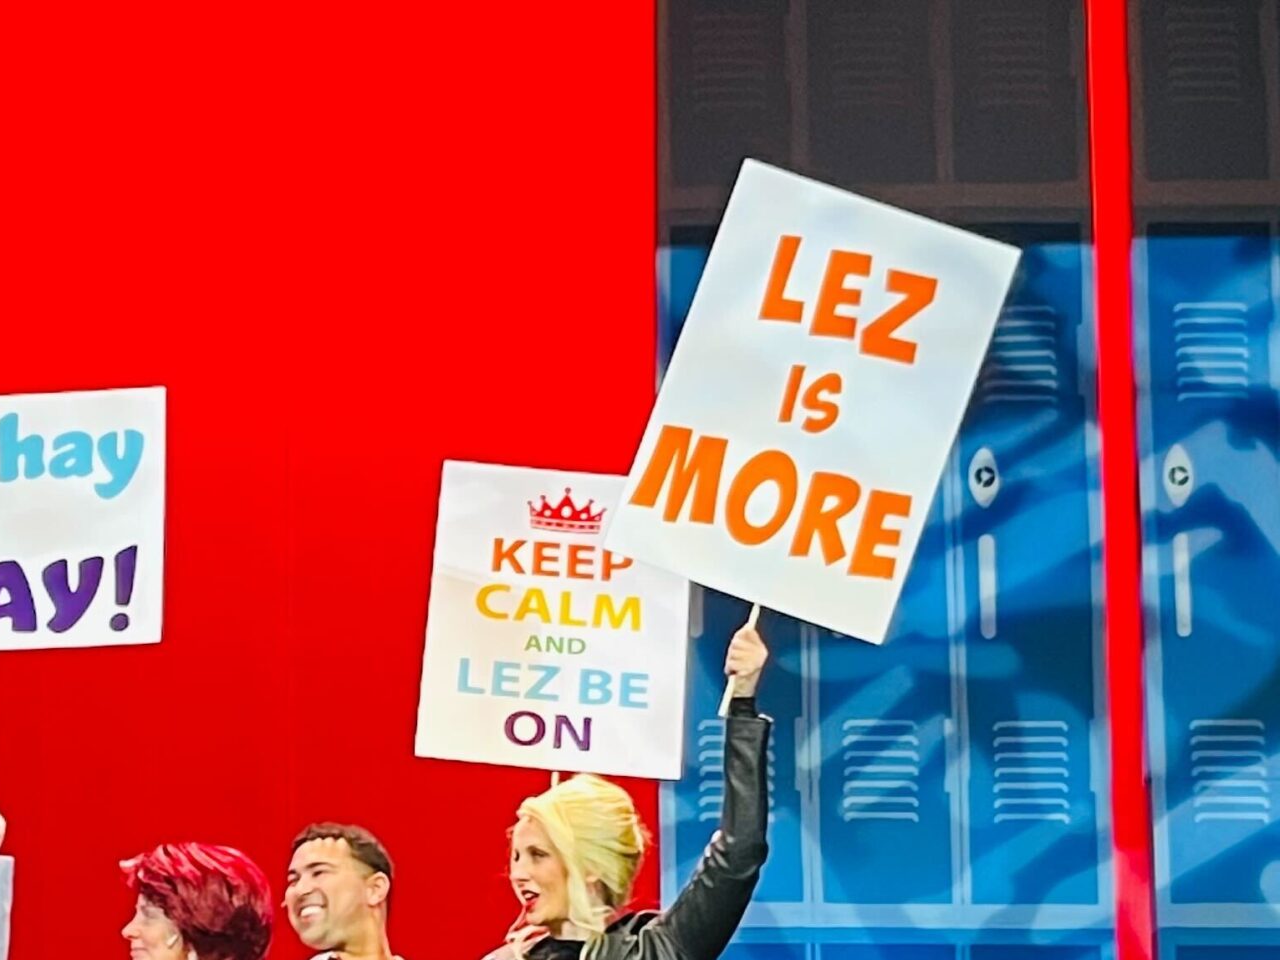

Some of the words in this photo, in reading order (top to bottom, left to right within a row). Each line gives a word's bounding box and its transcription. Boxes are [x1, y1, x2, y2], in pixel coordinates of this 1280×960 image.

[759, 235, 939, 365] LEZ
[778, 364, 842, 433] IS
[628, 425, 912, 580] MORE
[491, 537, 633, 582] KEEP
[475, 583, 642, 631] CALM
[524, 634, 586, 655] AND
[457, 657, 561, 702] LEZ
[578, 669, 649, 709] BE
[504, 710, 592, 751] ON
